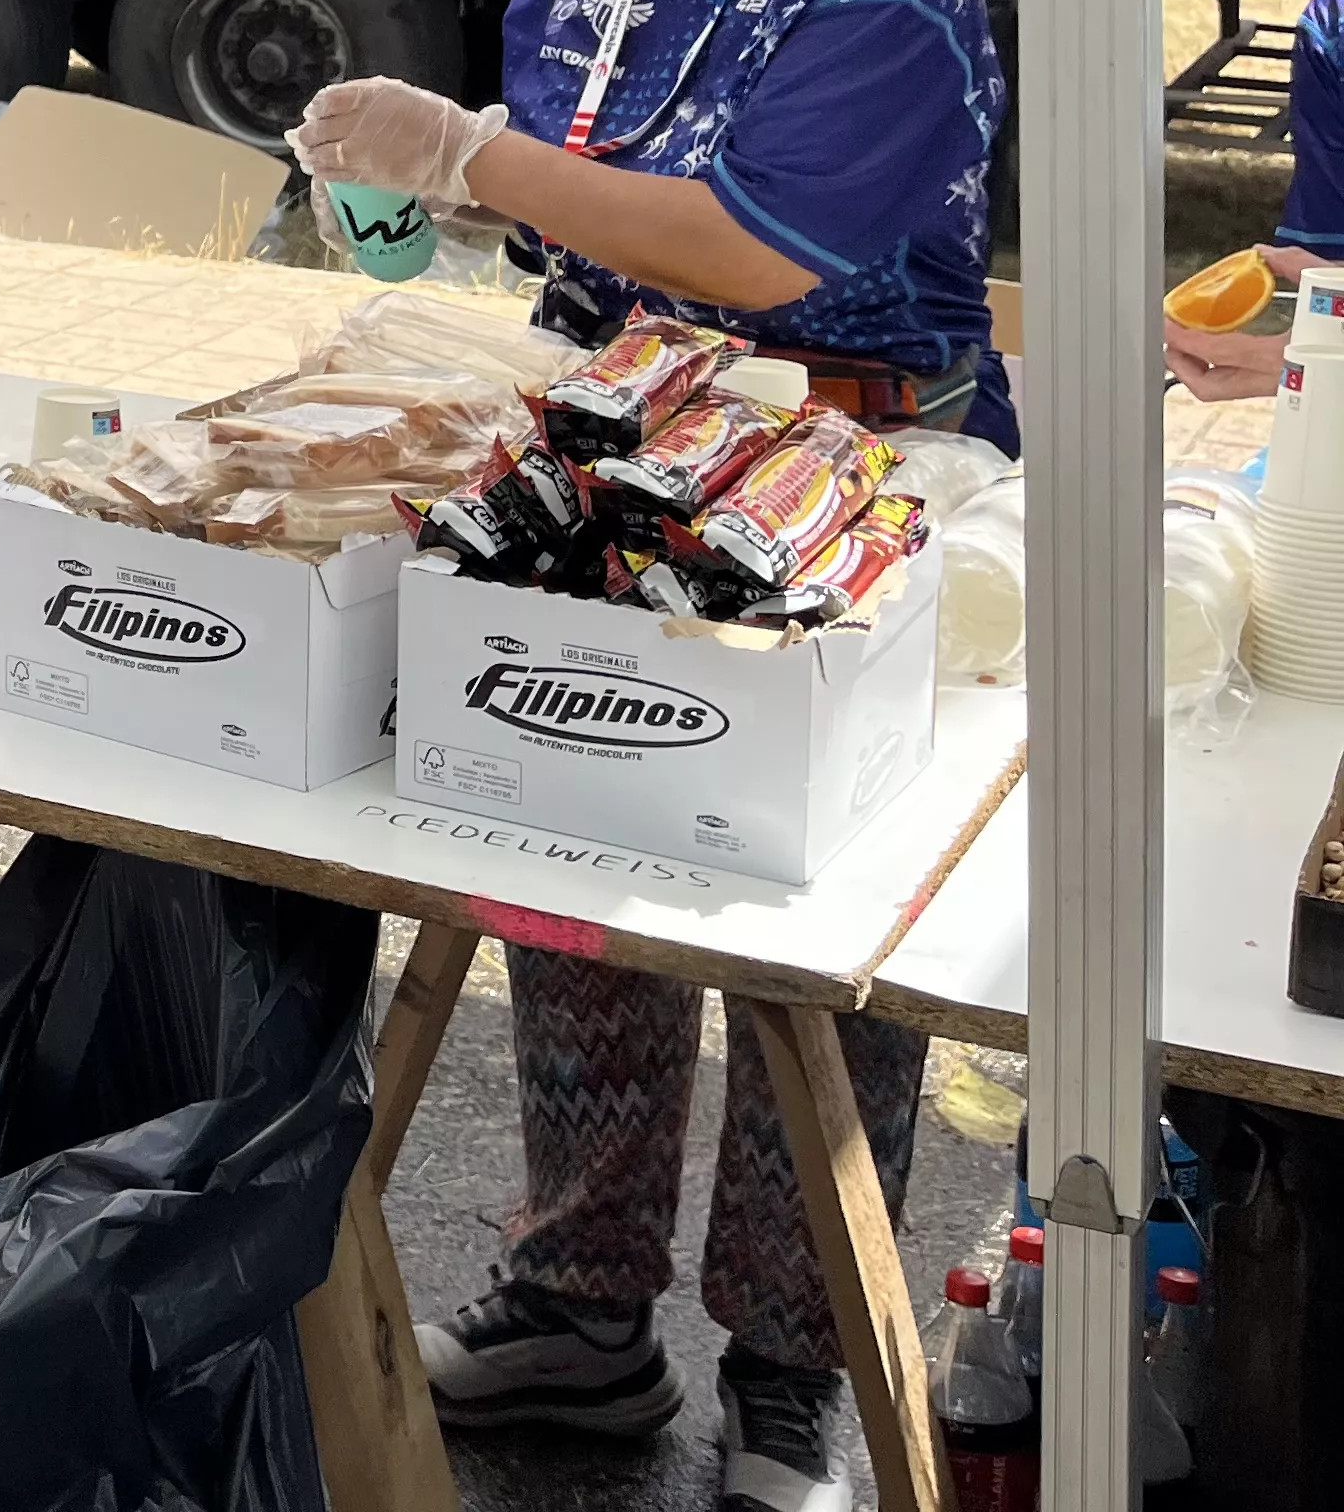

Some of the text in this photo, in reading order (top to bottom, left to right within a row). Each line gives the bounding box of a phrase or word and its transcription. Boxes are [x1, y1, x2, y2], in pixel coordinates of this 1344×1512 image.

[116, 571, 176, 592] LOS ORIGINALES
[44, 584, 229, 647] Filipinos
[485, 637, 528, 655] ARTIACH
[137, 659, 181, 676] CHOCOLATE
[561, 647, 639, 671] LOS ORIGINALES
[465, 663, 709, 732] Filipinos
[533, 735, 585, 755] AUTÉNTICO
[586, 746, 643, 762] CHOCOLATE
